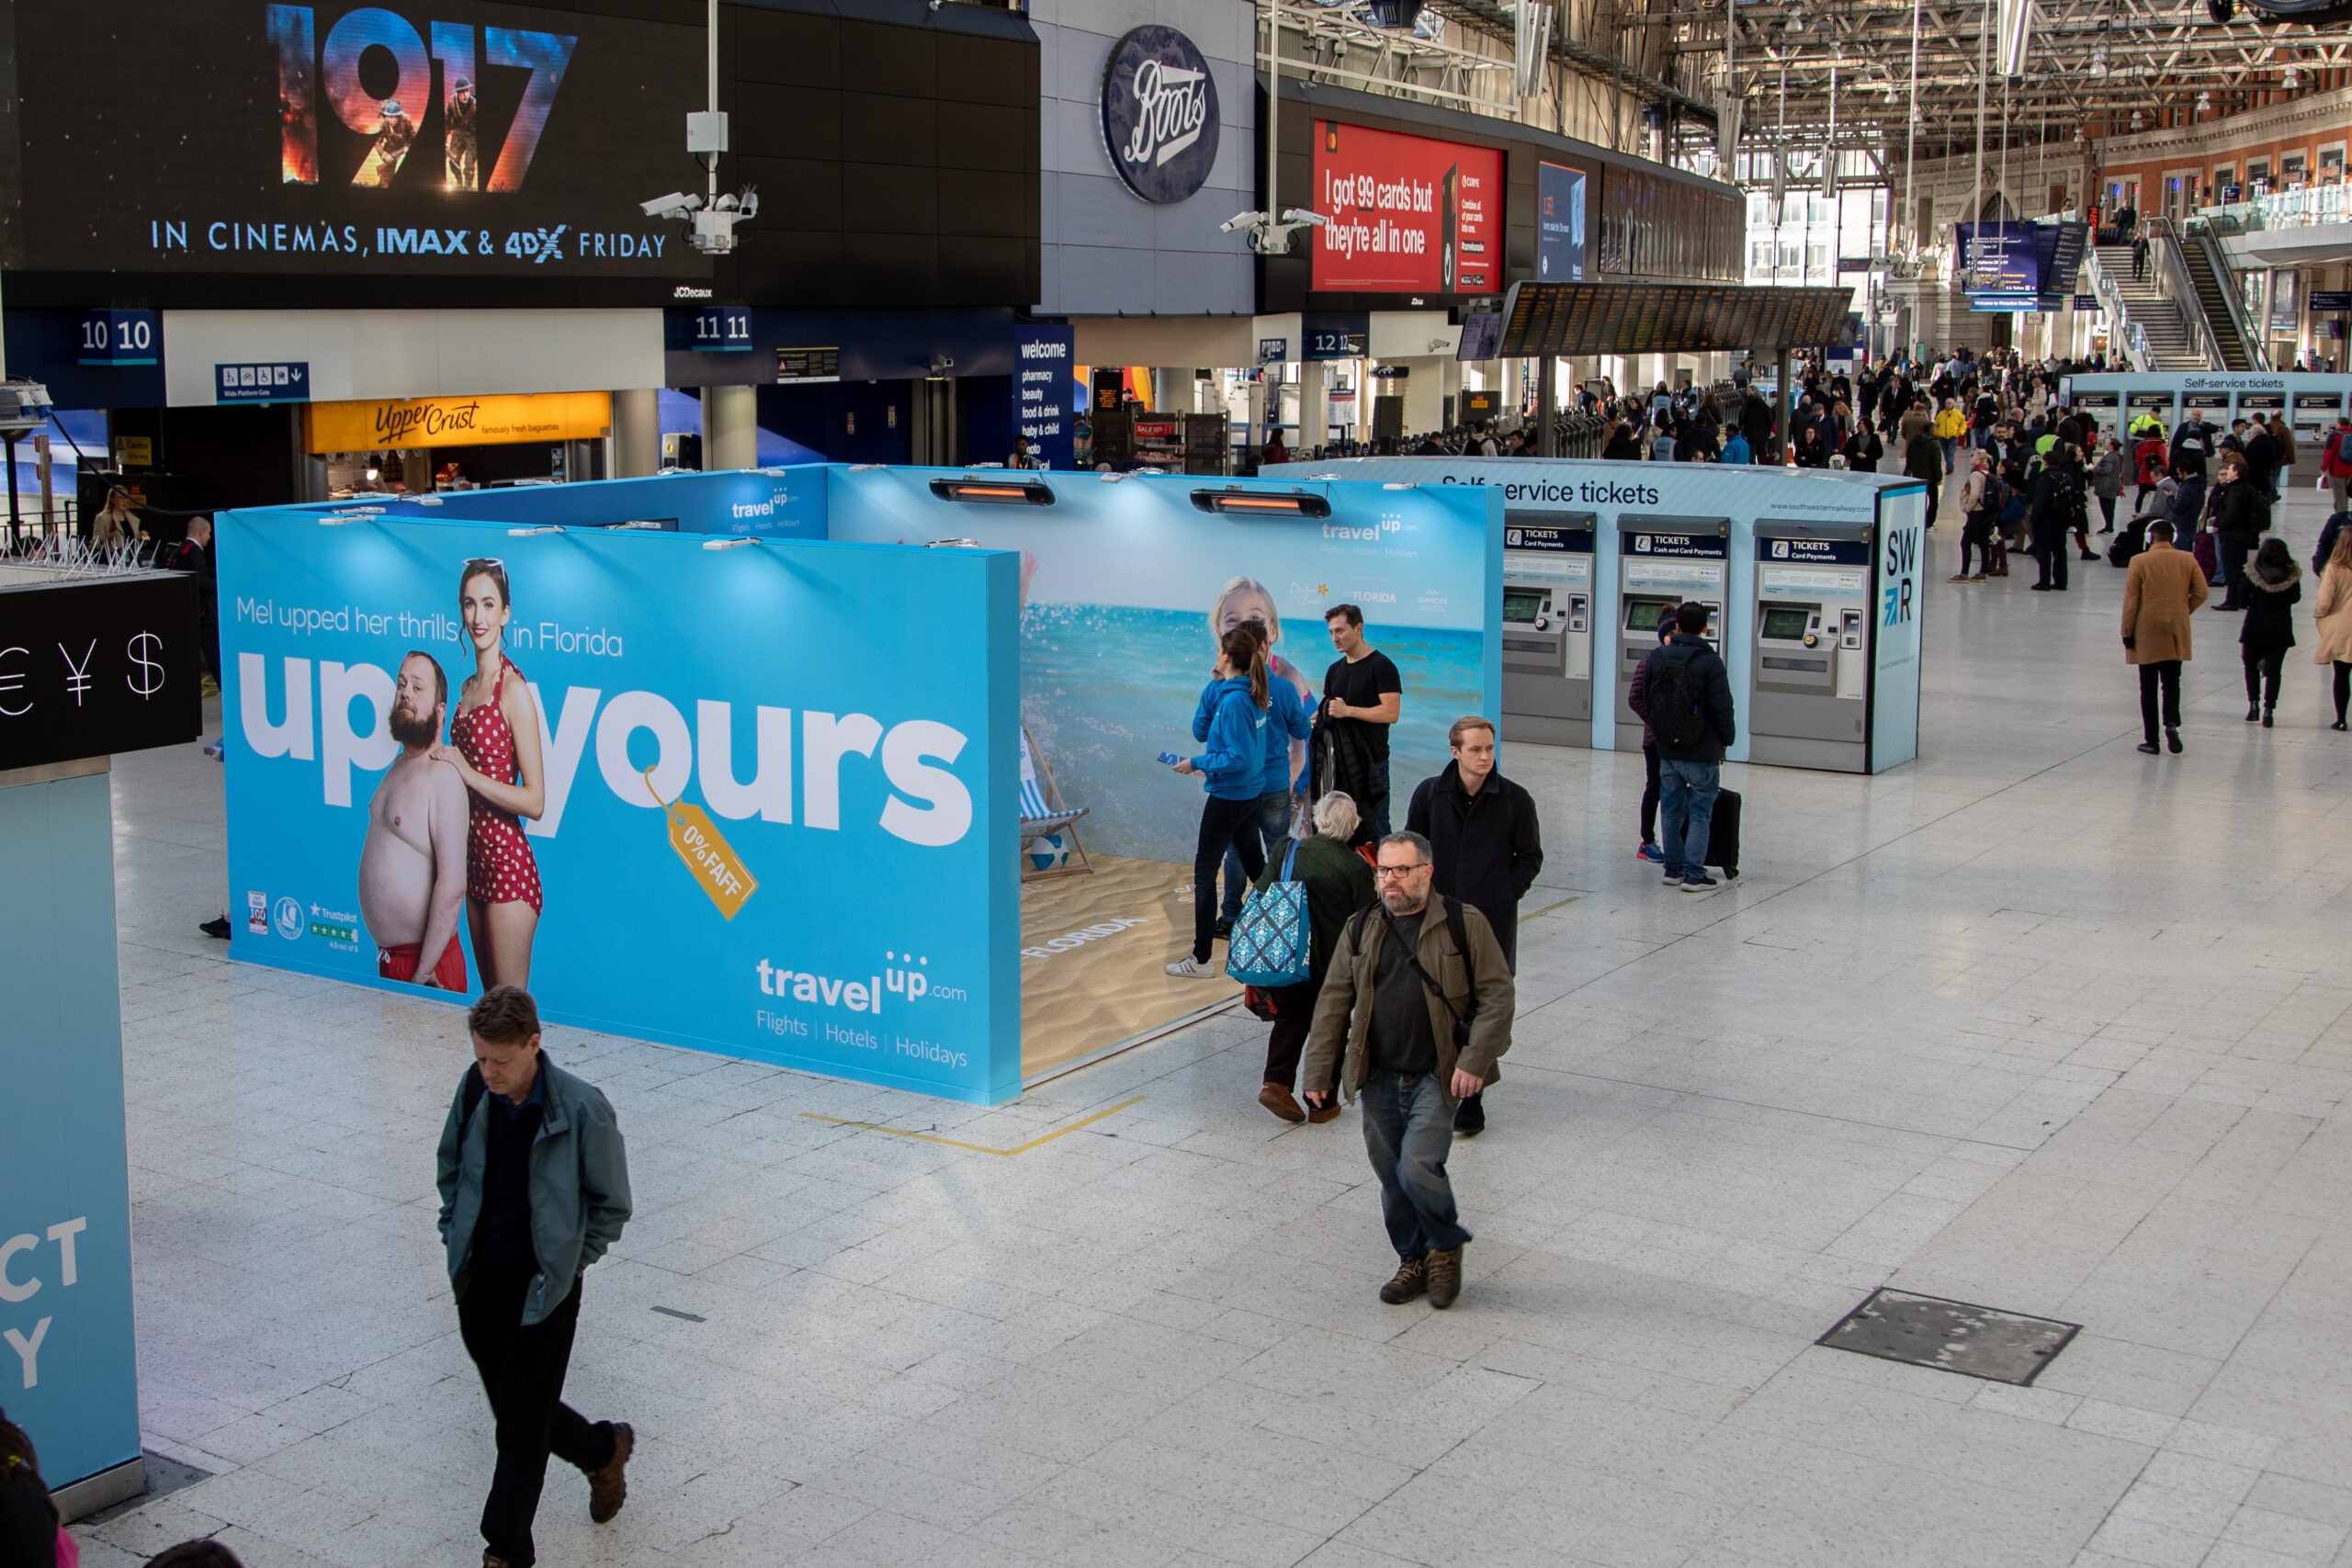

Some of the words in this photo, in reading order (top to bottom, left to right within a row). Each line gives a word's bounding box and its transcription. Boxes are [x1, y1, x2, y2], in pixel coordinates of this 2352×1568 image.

[266, 3, 579, 193] 1917
[1124, 60, 1205, 167] Boots
[1325, 169, 1330, 204] I
[1333, 174, 1355, 214] got
[1358, 175, 1374, 208] 99
[1377, 178, 1411, 211] cards
[1413, 179, 1432, 212] but
[152, 220, 187, 249] IN
[208, 220, 368, 258] CINEMAS,
[377, 228, 470, 255] IMAX
[477, 230, 494, 255] &
[504, 224, 568, 265] 4DX
[579, 231, 667, 258] FRIDAY
[1325, 216, 1370, 260] they're
[1372, 220, 1386, 253] all
[1389, 220, 1400, 254] in
[673, 287, 713, 299] JCDecaux
[82, 321, 108, 349] 10
[118, 321, 152, 350] 10
[695, 315, 721, 339] 11
[728, 315, 750, 339] 11
[1021, 339, 1067, 359] welcome
[1315, 334, 1336, 351] 12
[1340, 334, 1349, 350] 12
[1022, 369, 1053, 384] pharmacy
[2184, 378, 2246, 389] Self-service
[2249, 378, 2284, 389] tickets
[1022, 388, 1044, 401] beauty
[1022, 406, 1035, 419] food
[1037, 407, 1043, 417] &
[1044, 405, 1059, 417] drink
[375, 401, 435, 445] Upper
[425, 400, 481, 435] Crust
[481, 424, 510, 435] famously
[511, 423, 527, 433] fresh
[528, 423, 560, 434] baguettes
[1022, 424, 1038, 439] baby
[1039, 424, 1044, 435] &
[1045, 423, 1060, 435] child
[1580, 480, 1658, 504] tickets
[1770, 502, 1871, 513] www.southwesternrailway.com
[1524, 530, 1558, 539] TICKETS
[1655, 536, 1690, 546] TICKETS
[1385, 549, 1418, 558] Holidays
[1537, 541, 1564, 549] Payments
[1693, 548, 1722, 557] Payments
[1792, 541, 1830, 551] TICKETS
[1886, 526, 1917, 577] SW
[1806, 553, 1836, 561] Payments
[1353, 591, 1396, 604] FLORIDA
[1900, 578, 1912, 624] R
[236, 596, 273, 626] Mel
[279, 604, 350, 637] upped
[356, 601, 392, 636] her
[399, 611, 458, 642] thrills
[513, 620, 533, 649] in
[540, 623, 623, 658] Florida
[59, 638, 96, 706] ¥
[127, 630, 164, 701] $
[238, 652, 401, 808] up
[525, 682, 973, 847] yours
[683, 825, 707, 862] 0%
[703, 849, 742, 899] FAFF
[322, 908, 357, 923] Trustpilot
[1021, 918, 1148, 959] FLORIDA
[757, 1010, 808, 1037] Flights
[826, 1023, 877, 1050] Hotels
[896, 1036, 967, 1067] Holidays
